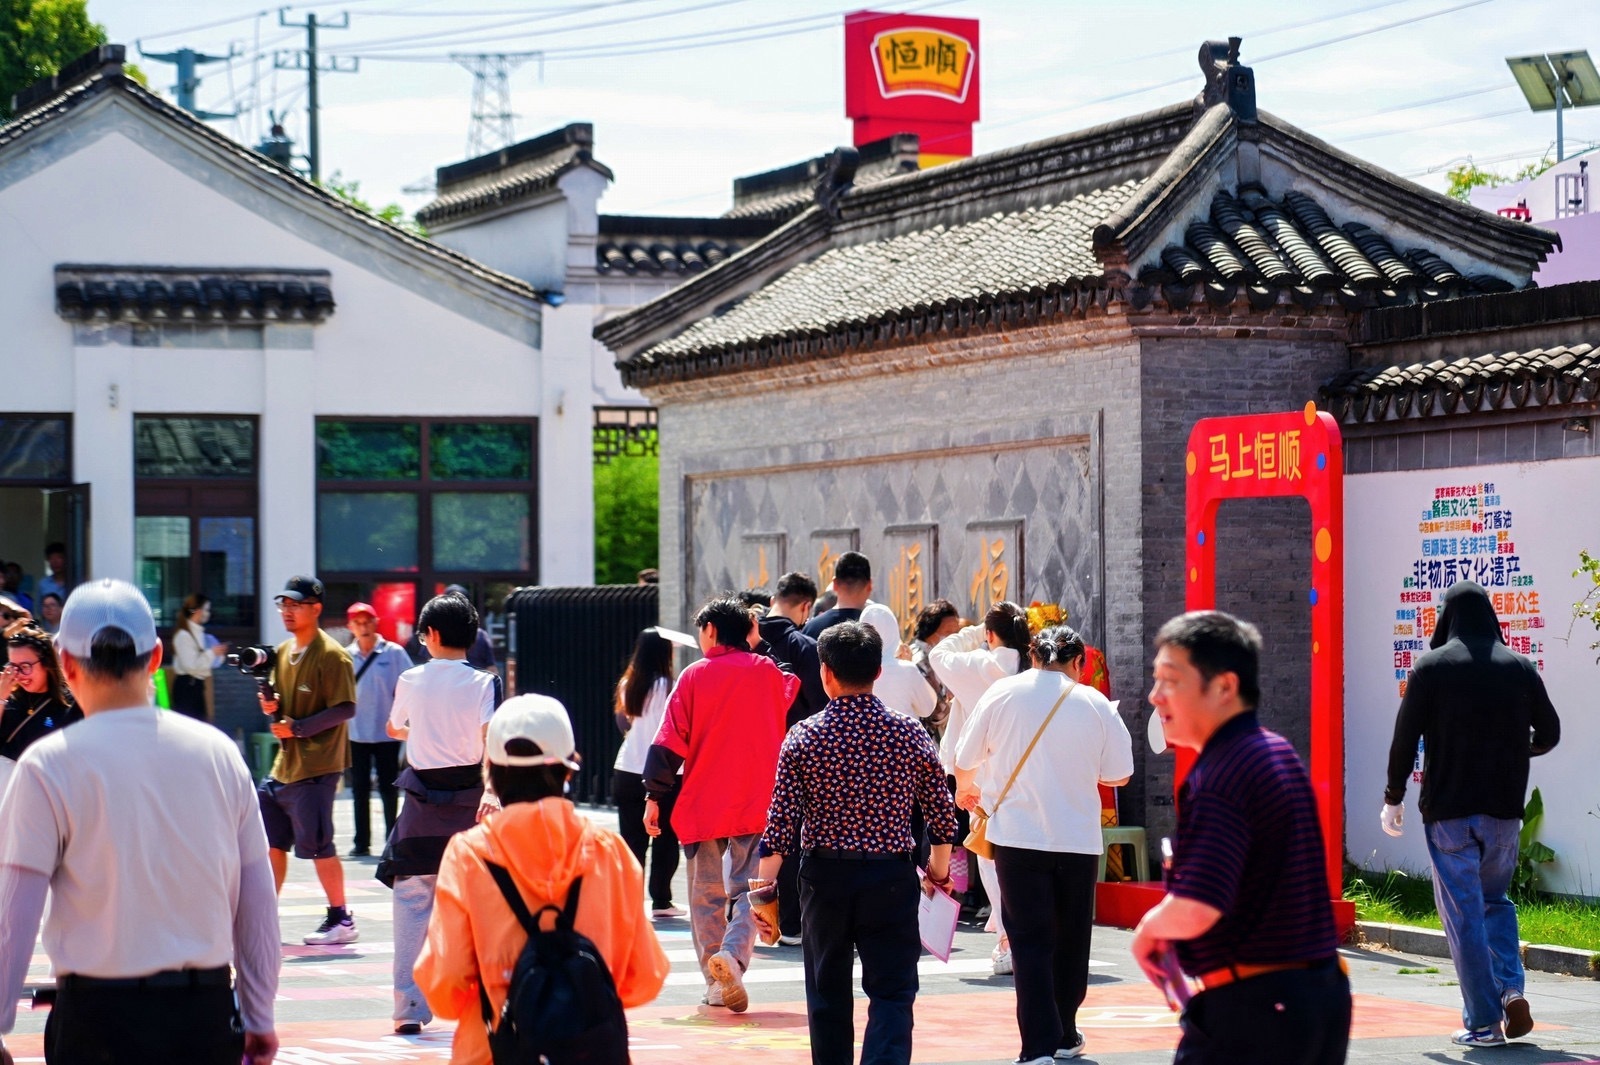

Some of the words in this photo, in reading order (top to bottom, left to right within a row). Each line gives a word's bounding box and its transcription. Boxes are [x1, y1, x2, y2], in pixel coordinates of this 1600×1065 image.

[885, 37, 958, 75] 恒順
[1208, 430, 1302, 482] 马上恒顺
[1432, 497, 1478, 518] 酱醋文化节
[1484, 510, 1512, 530] 打酱油
[1422, 538, 1458, 557] 恒顺味道
[1459, 535, 1497, 555] 全球共享
[1413, 556, 1520, 589] 非物质文化遗产
[1492, 591, 1541, 615] 恒顺众生
[1527, 617, 1545, 628] 北固山
[1511, 635, 1531, 654] 陈醋
